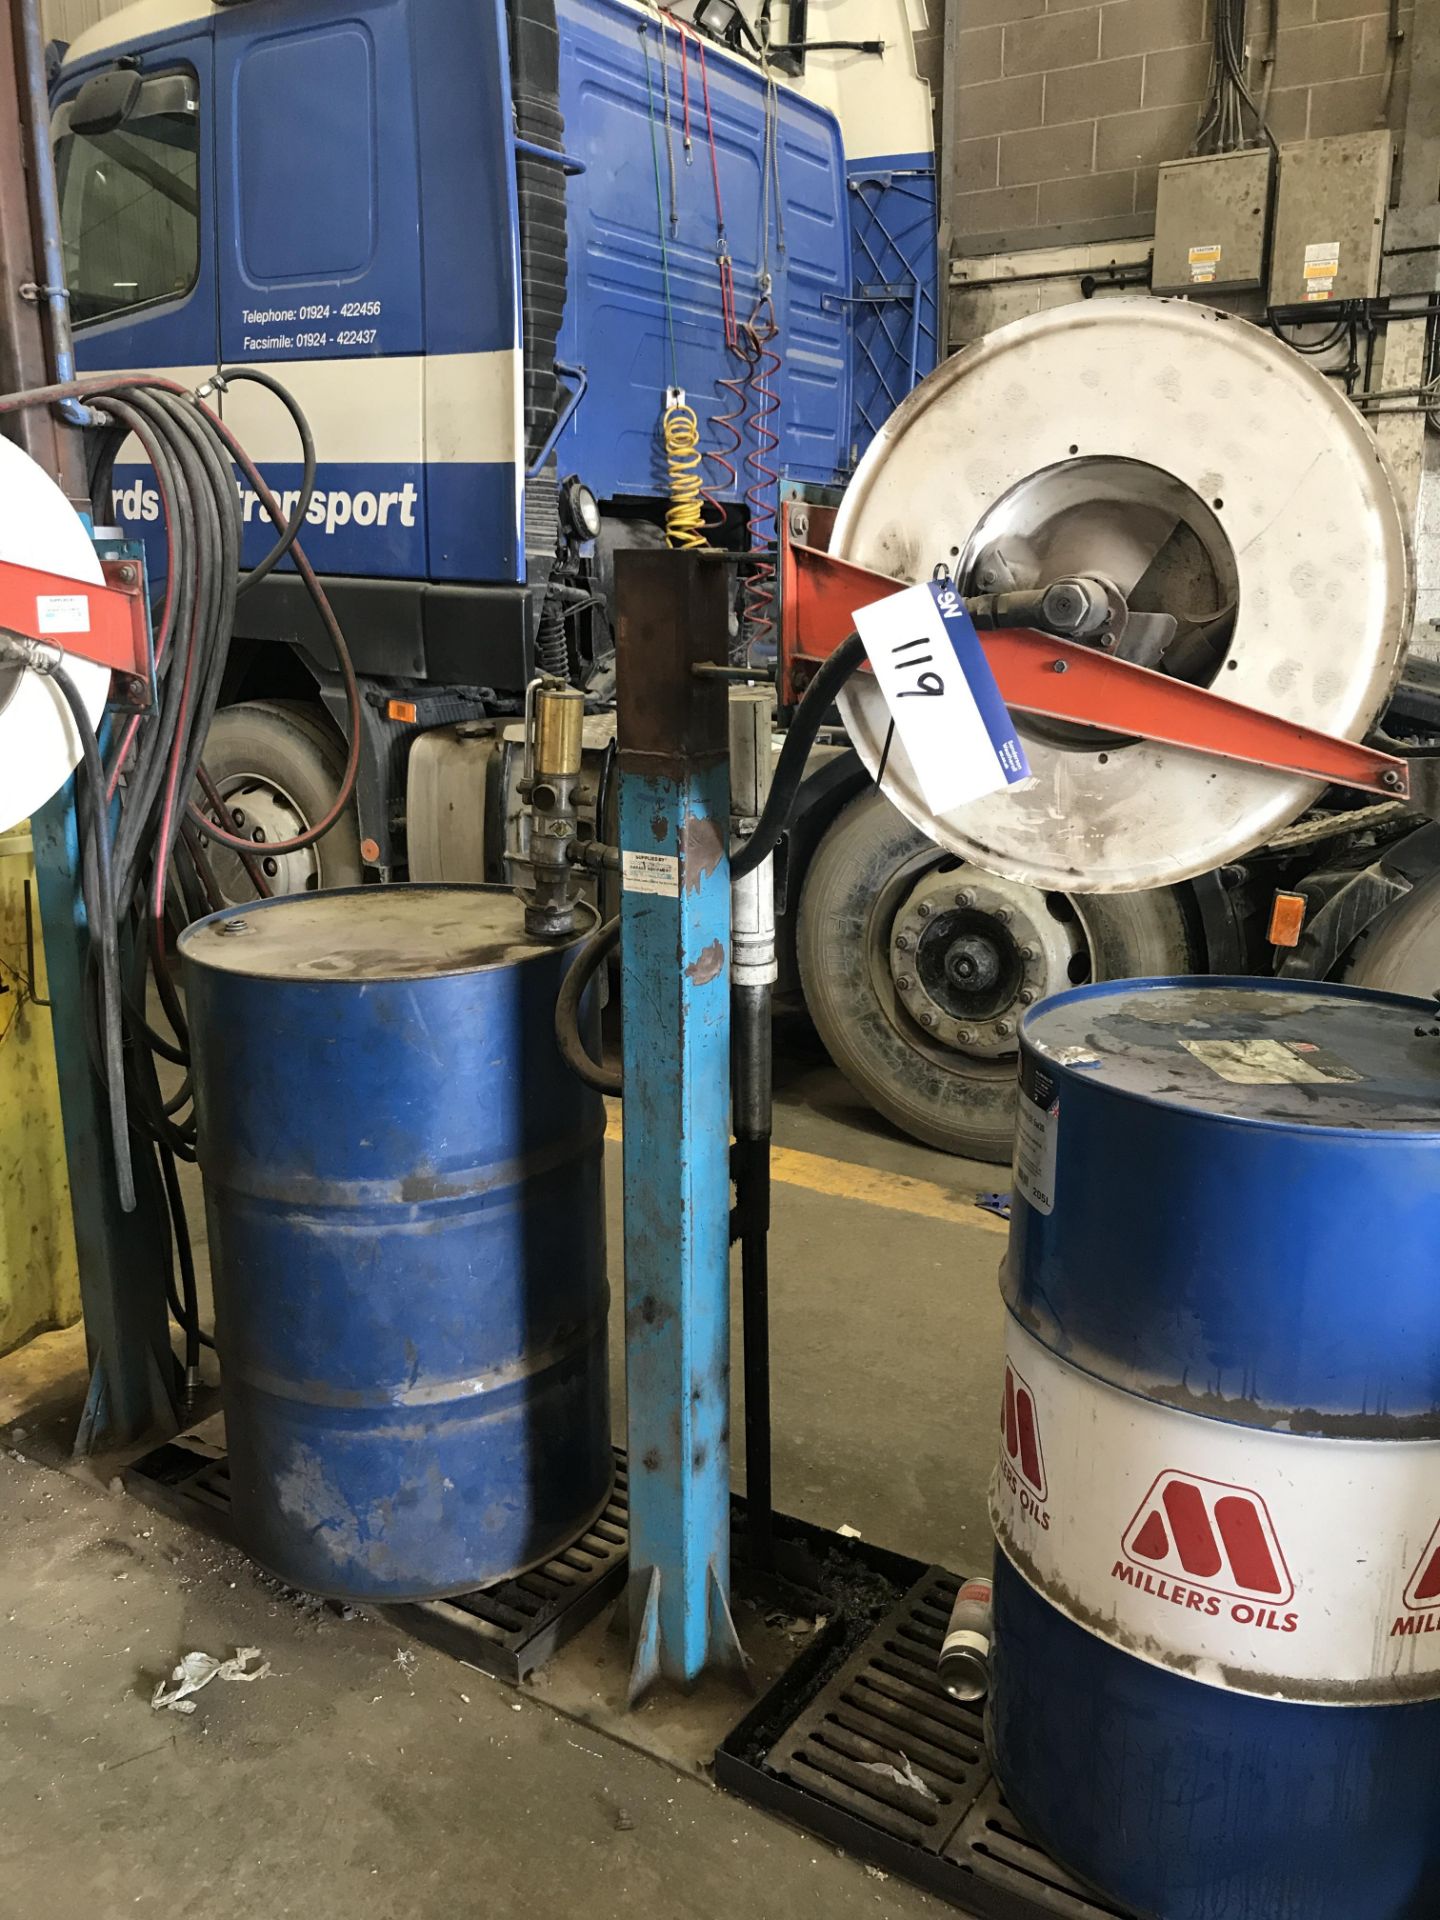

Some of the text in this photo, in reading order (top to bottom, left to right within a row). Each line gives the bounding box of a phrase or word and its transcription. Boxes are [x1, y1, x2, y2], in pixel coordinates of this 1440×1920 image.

[242, 309, 297, 325] Telephone:
[299, 305, 330, 320] 01924
[340, 301, 381, 317] 422456
[243, 335, 294, 350] Facsimile:
[296, 332, 326, 347] 01924
[336, 329, 377, 345] 422437
[112, 479, 160, 521] rds
[891, 637, 945, 698] 119
[1032, 1187, 1051, 1208] 205L
[1000, 1456, 1050, 1530] LERS OILS
[1111, 1561, 1299, 1632] MILLERS OILS
